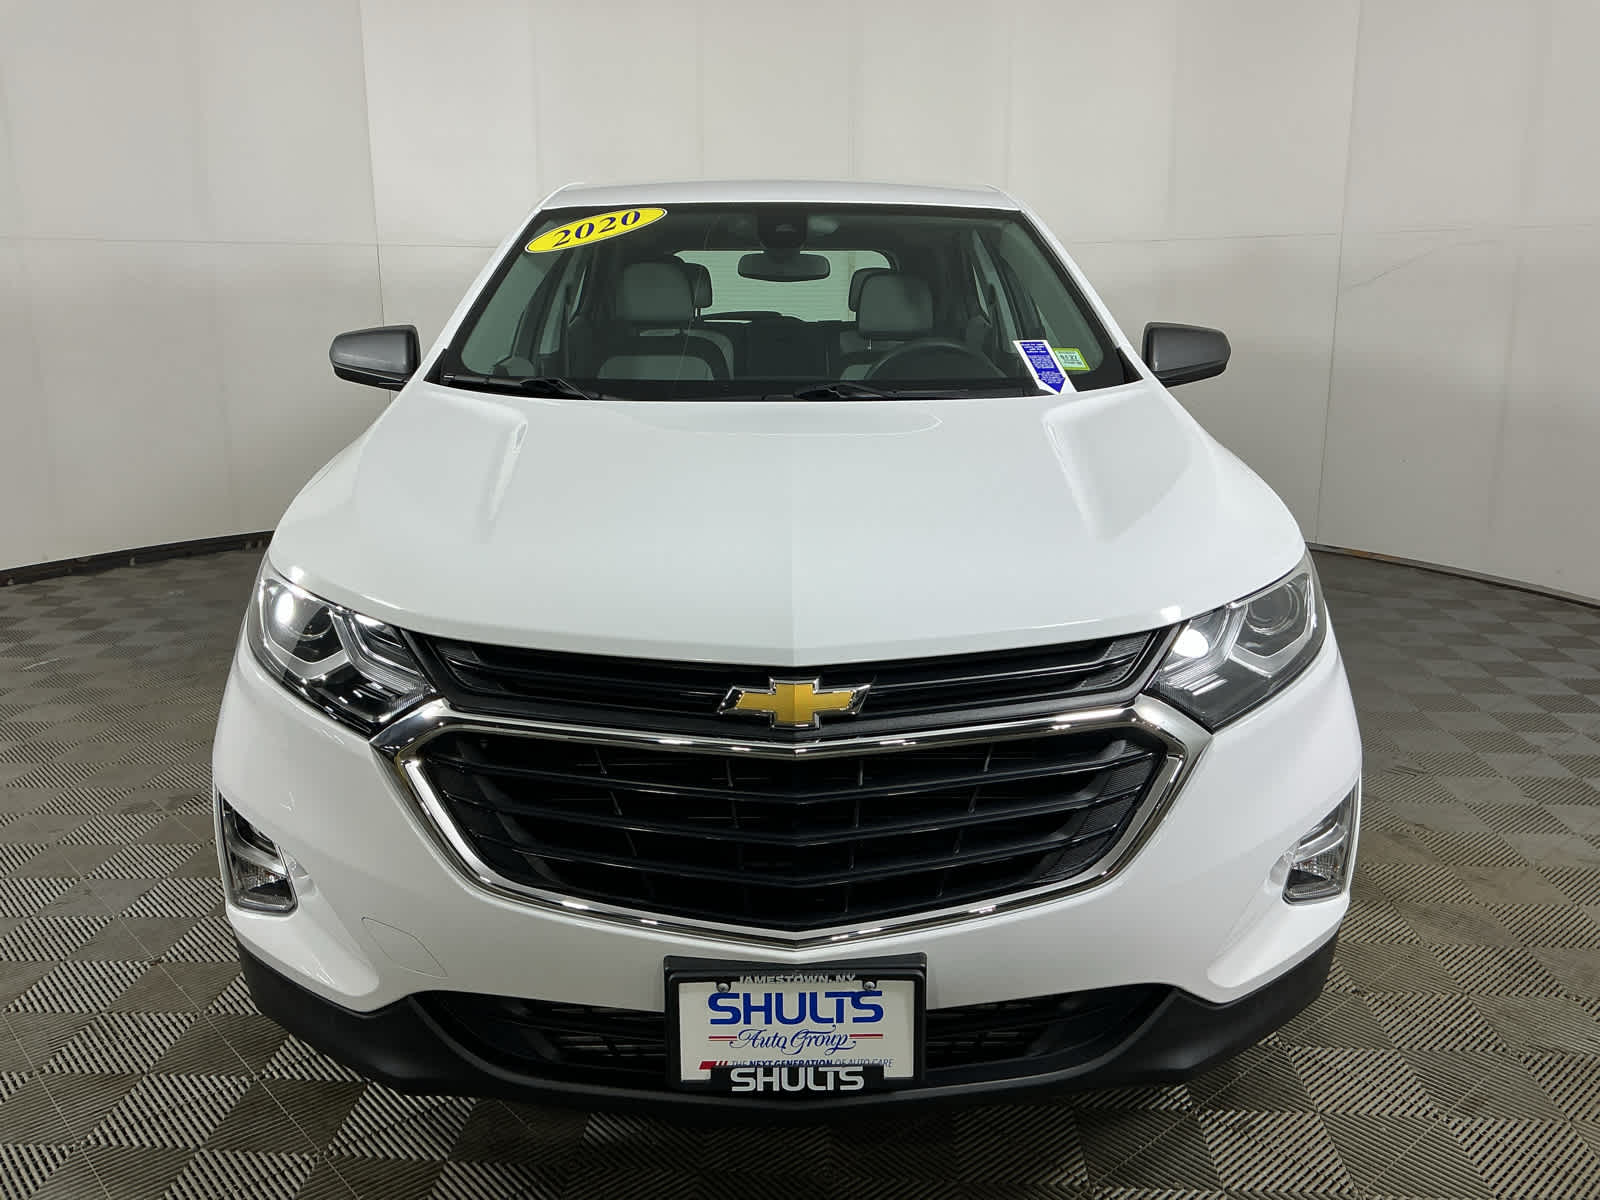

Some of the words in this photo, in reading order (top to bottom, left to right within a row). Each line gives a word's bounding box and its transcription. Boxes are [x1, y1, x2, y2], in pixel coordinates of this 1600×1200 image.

[552, 211, 640, 248] 2020
[835, 973, 856, 984] NY
[708, 990, 884, 1025] SHULTS
[730, 1028, 787, 1050] Auto
[781, 1024, 857, 1056] Group
[870, 1058, 893, 1068] CARE
[730, 1066, 865, 1091] SHULTS
